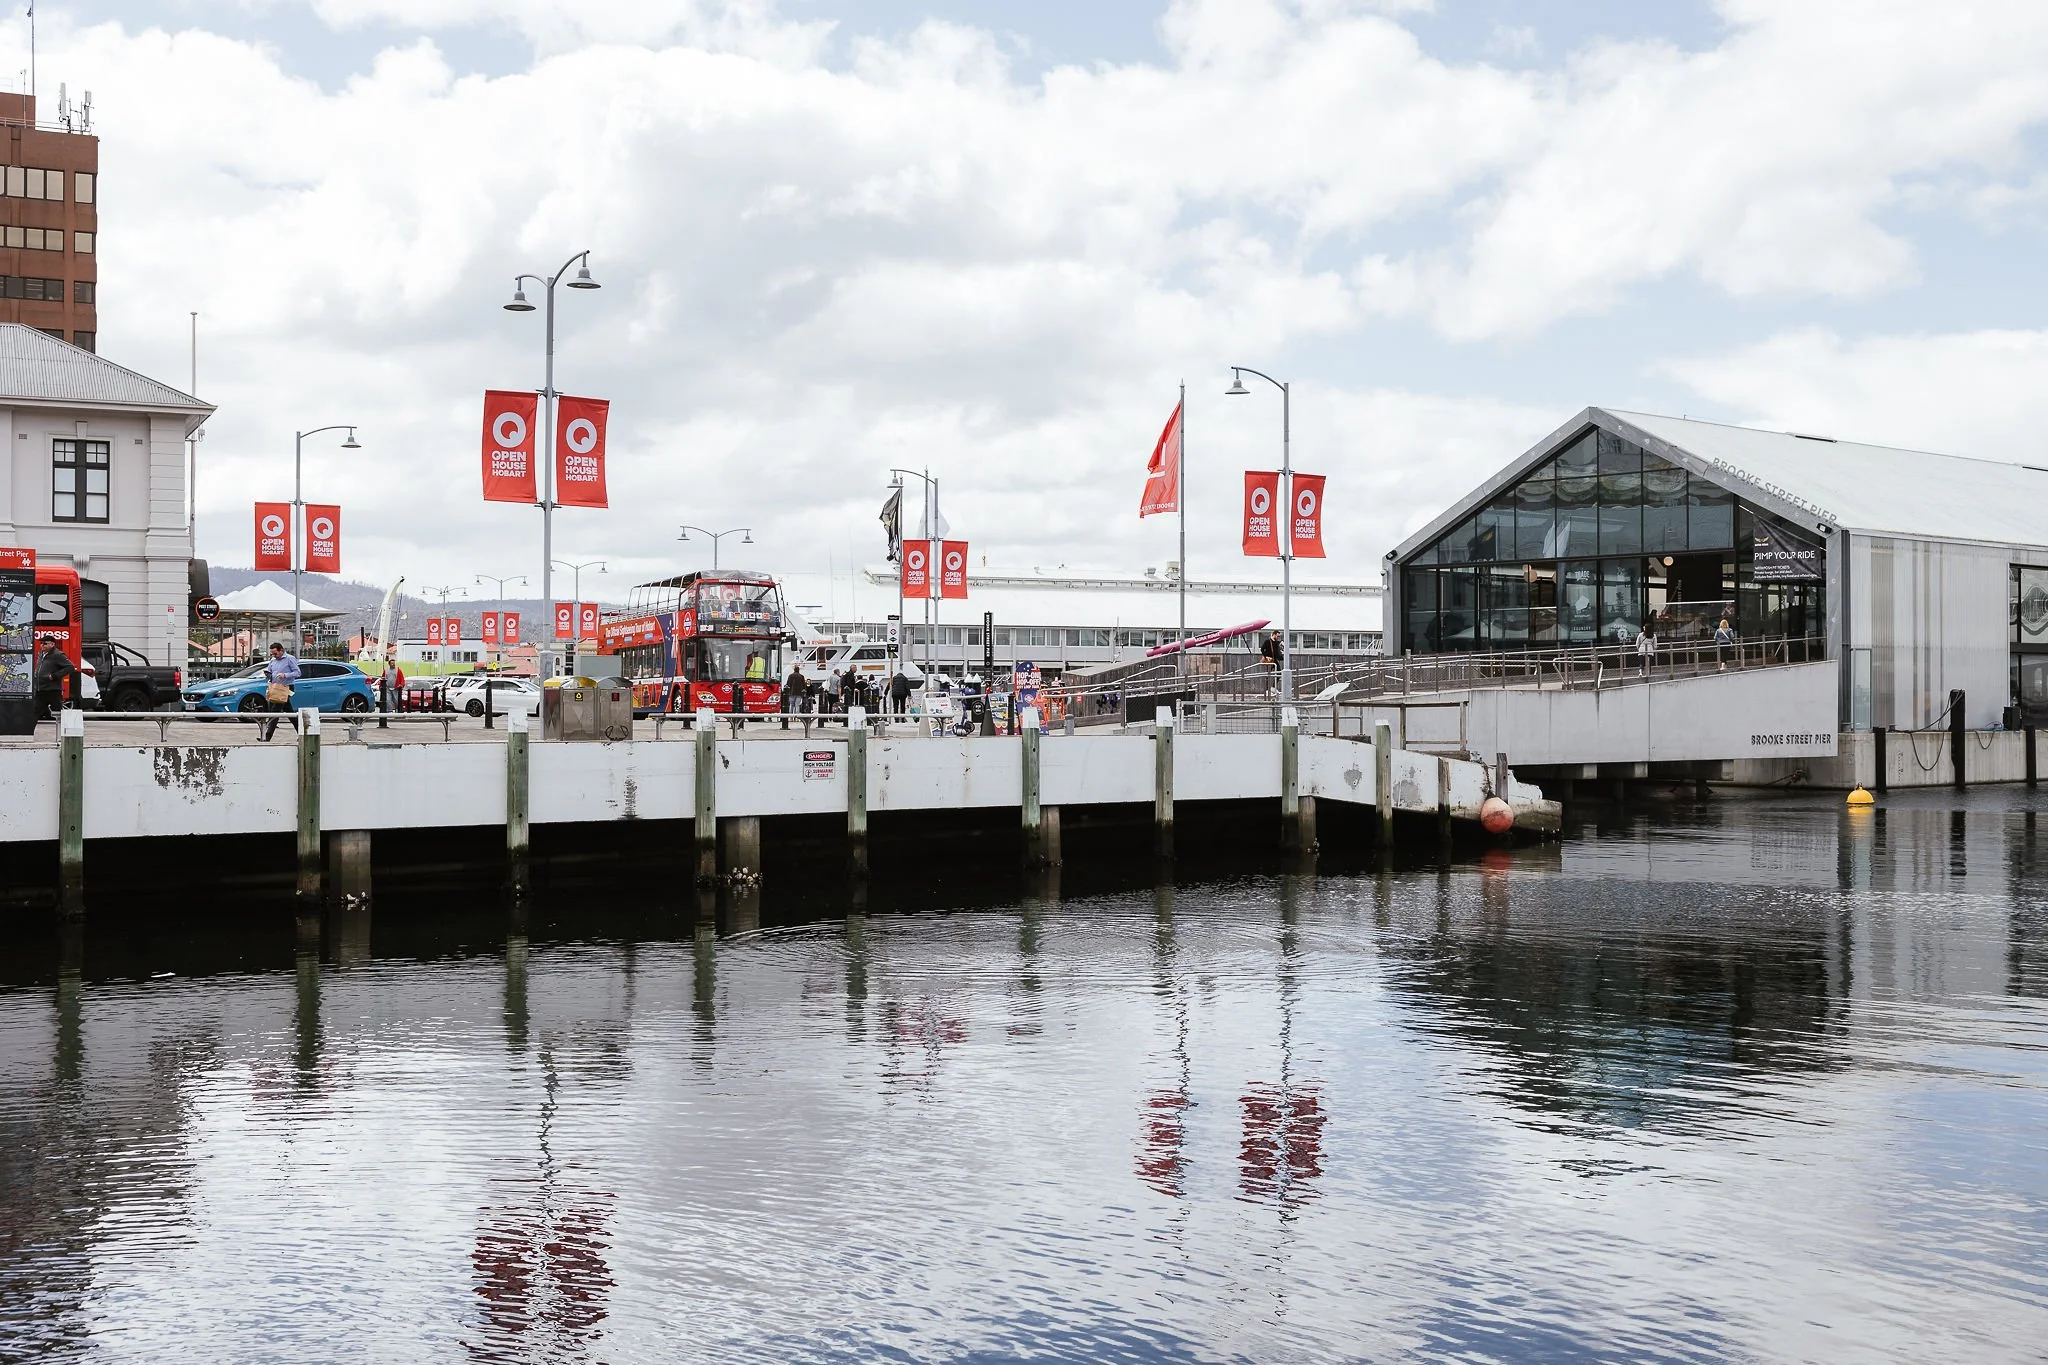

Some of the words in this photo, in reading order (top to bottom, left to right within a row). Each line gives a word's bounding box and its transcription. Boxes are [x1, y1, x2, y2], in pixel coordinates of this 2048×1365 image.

[492, 450, 526, 461] OPEN
[492, 461, 526, 470] HOUSE
[565, 456, 597, 467] OPEN
[565, 466, 598, 475] HOUSE
[1712, 457, 1762, 486] BROOKE
[1764, 482, 1808, 508] STREET
[1810, 504, 1837, 523] PIER
[1249, 517, 1270, 525] OPEN
[1754, 552, 1773, 560] PIMP
[1798, 550, 1815, 559] RIDE
[36, 594, 67, 620] S
[1751, 735, 1783, 745] BROOKE
[1786, 734, 1812, 744] STREET
[1814, 734, 1831, 744] PIER
